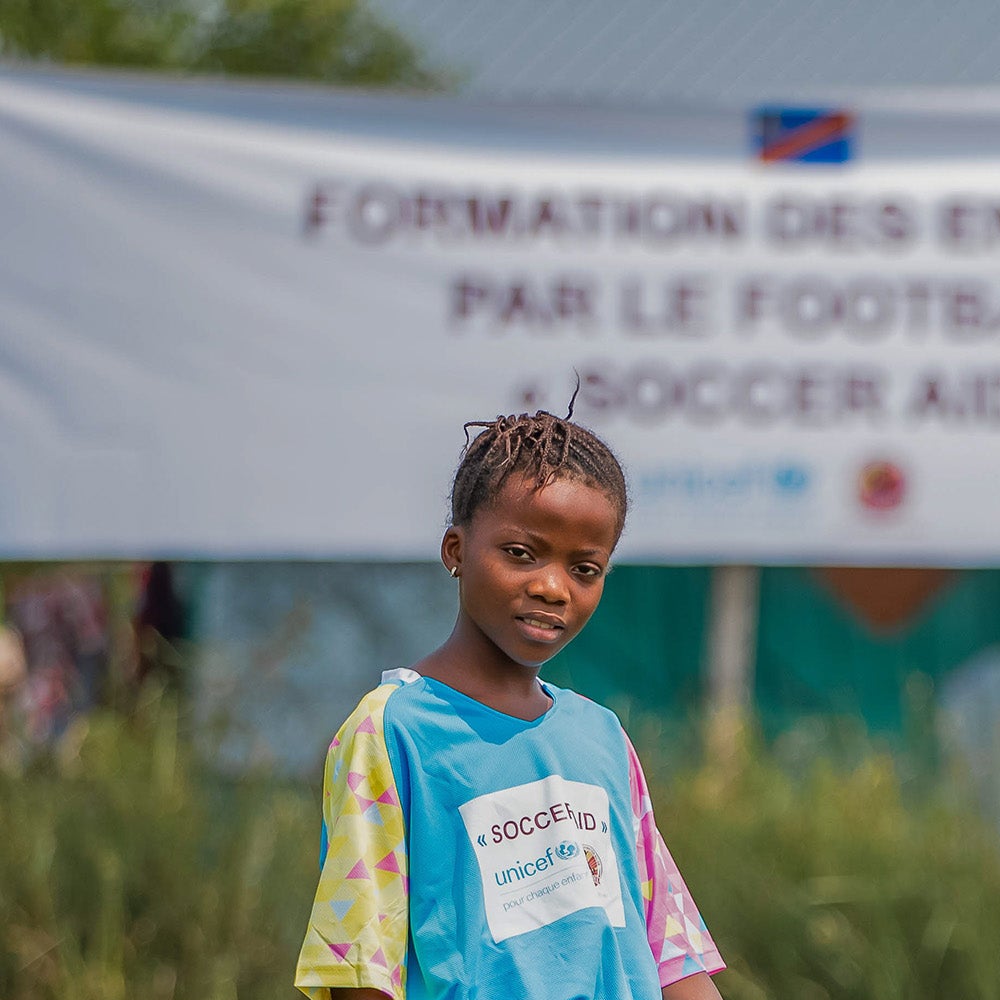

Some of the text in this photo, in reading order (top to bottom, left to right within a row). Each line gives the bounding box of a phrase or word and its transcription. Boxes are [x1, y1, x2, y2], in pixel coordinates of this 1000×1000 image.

[303, 185, 742, 246] FORMATION
[770, 194, 914, 254] DES
[450, 275, 596, 334] PAR
[620, 275, 712, 337] LE
[578, 365, 891, 427] SOCCER
[495, 847, 554, 886] unicef
[526, 880, 561, 902] chaque
